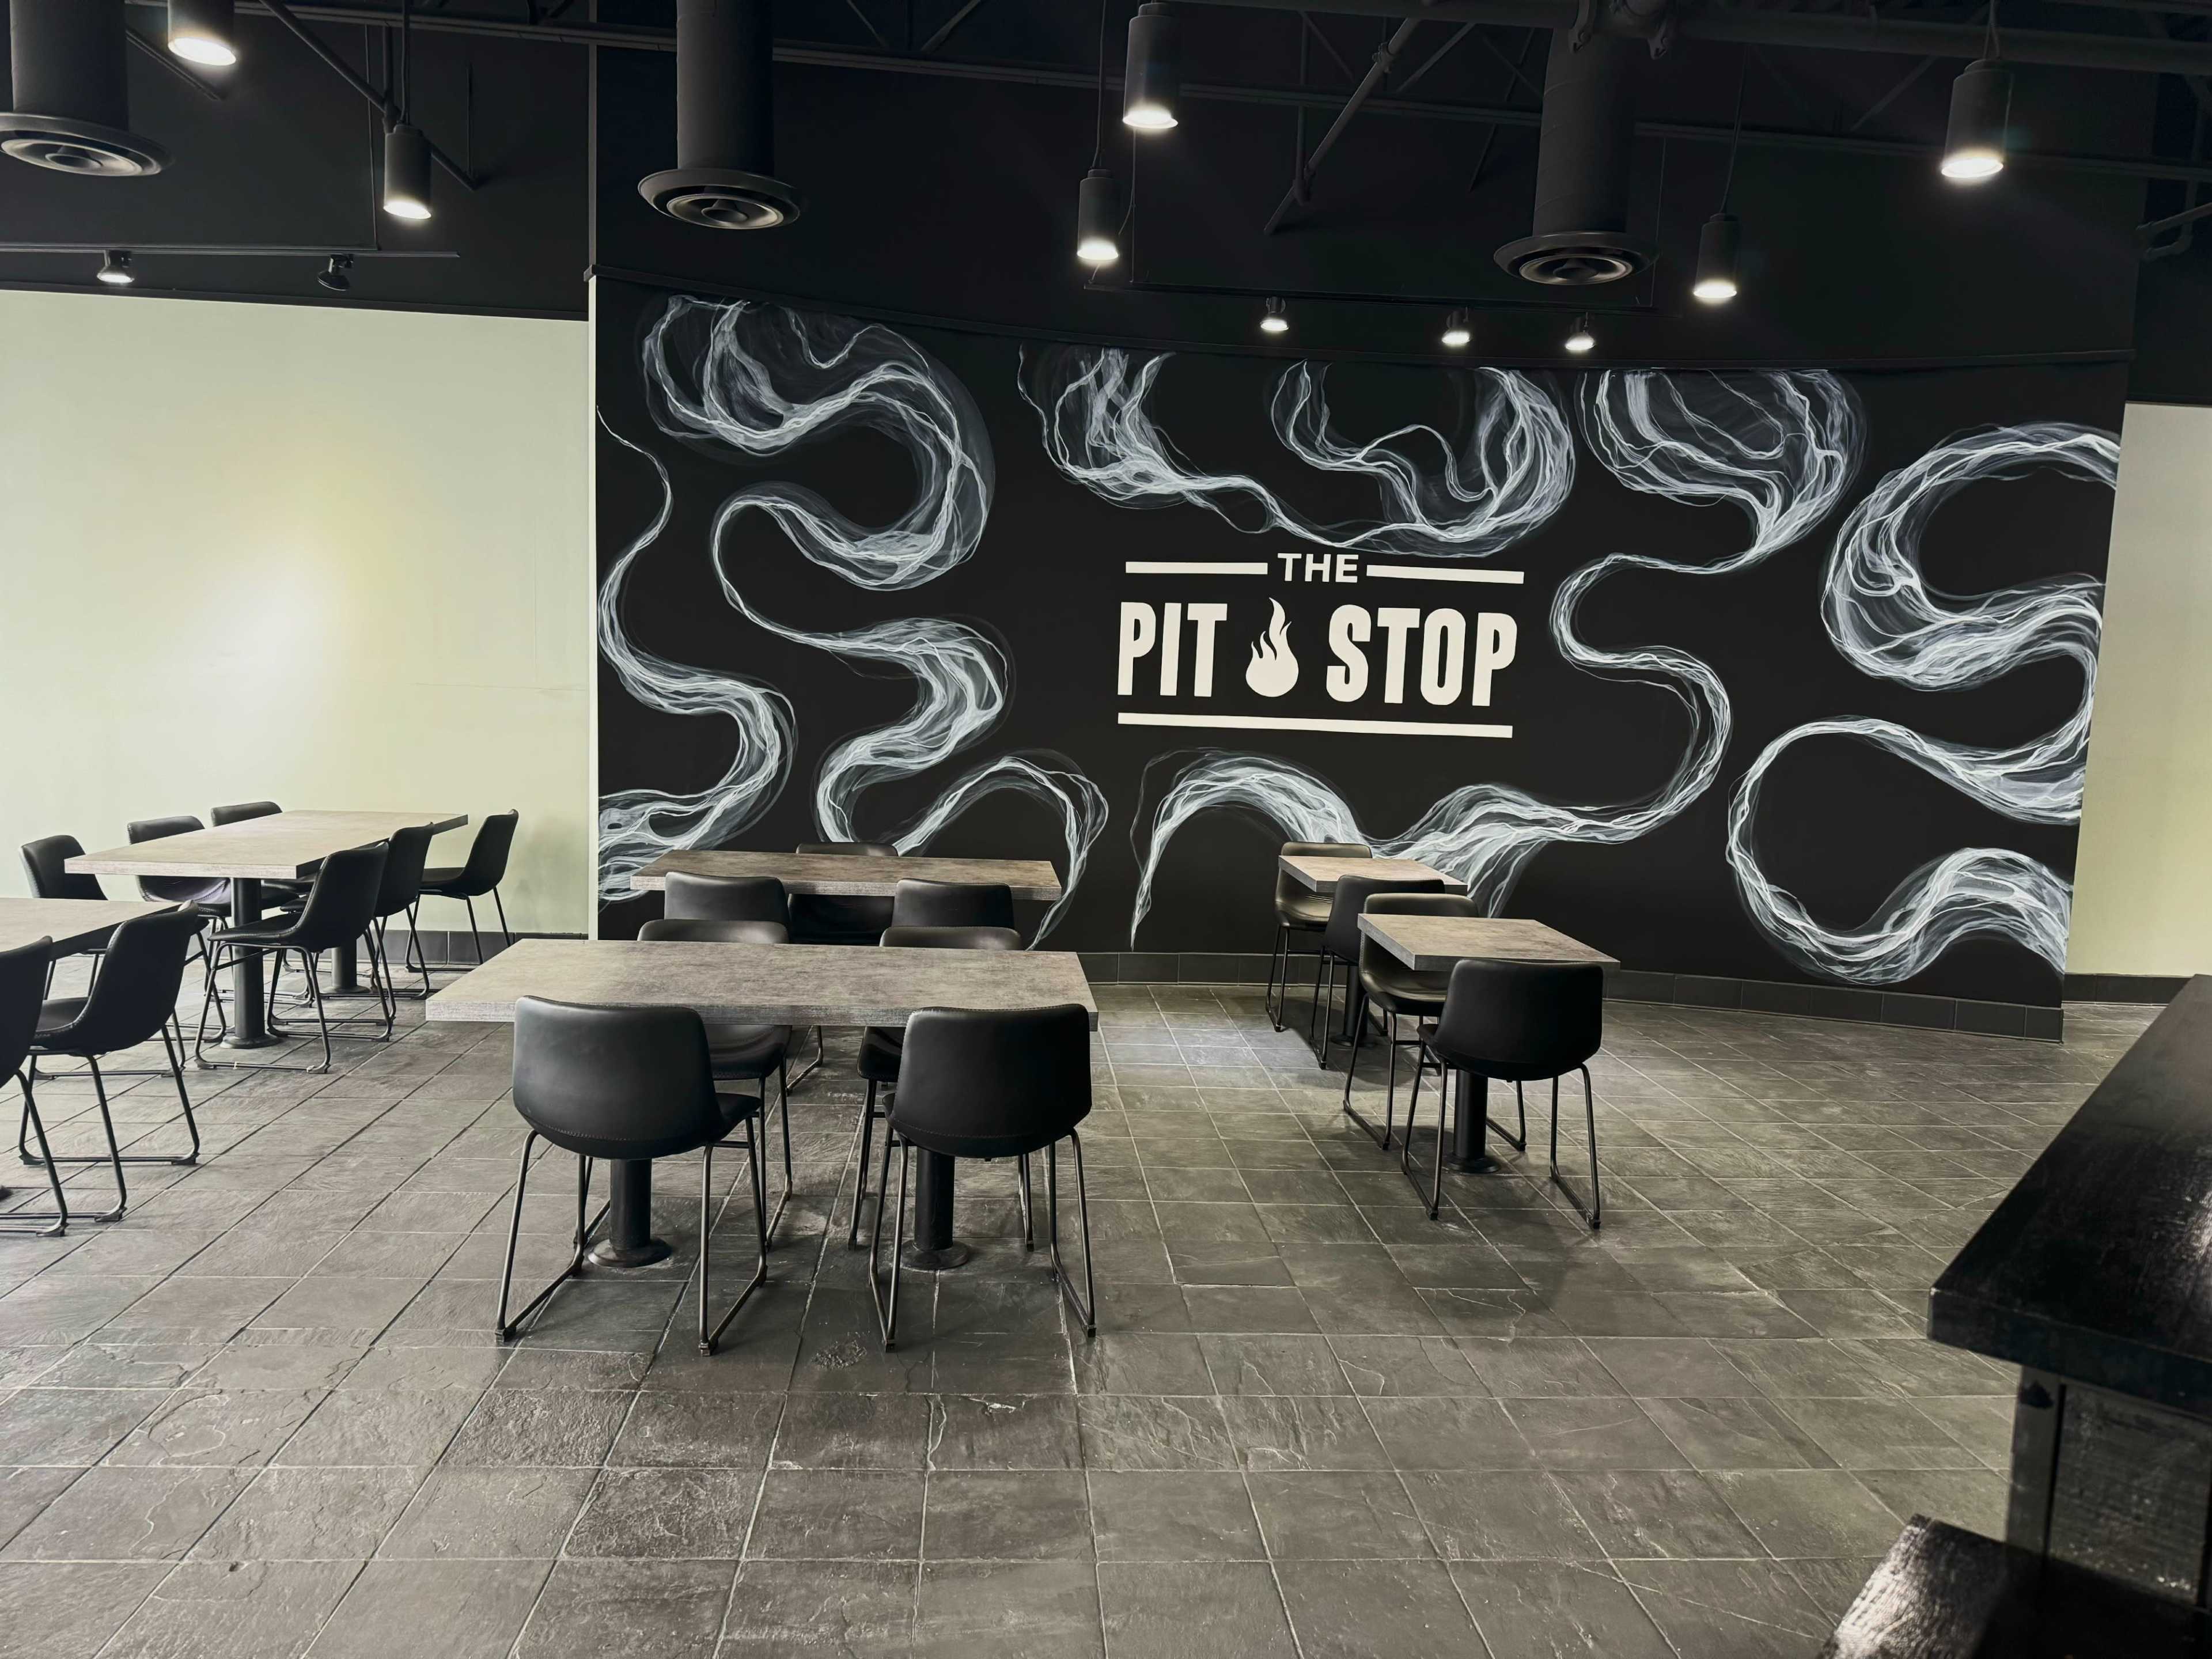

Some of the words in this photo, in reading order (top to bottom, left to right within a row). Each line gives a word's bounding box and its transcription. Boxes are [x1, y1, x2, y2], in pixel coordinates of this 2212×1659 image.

[1277, 552, 1359, 584] THE
[1117, 601, 1228, 696] PIT
[1325, 604, 1517, 706] STOP
